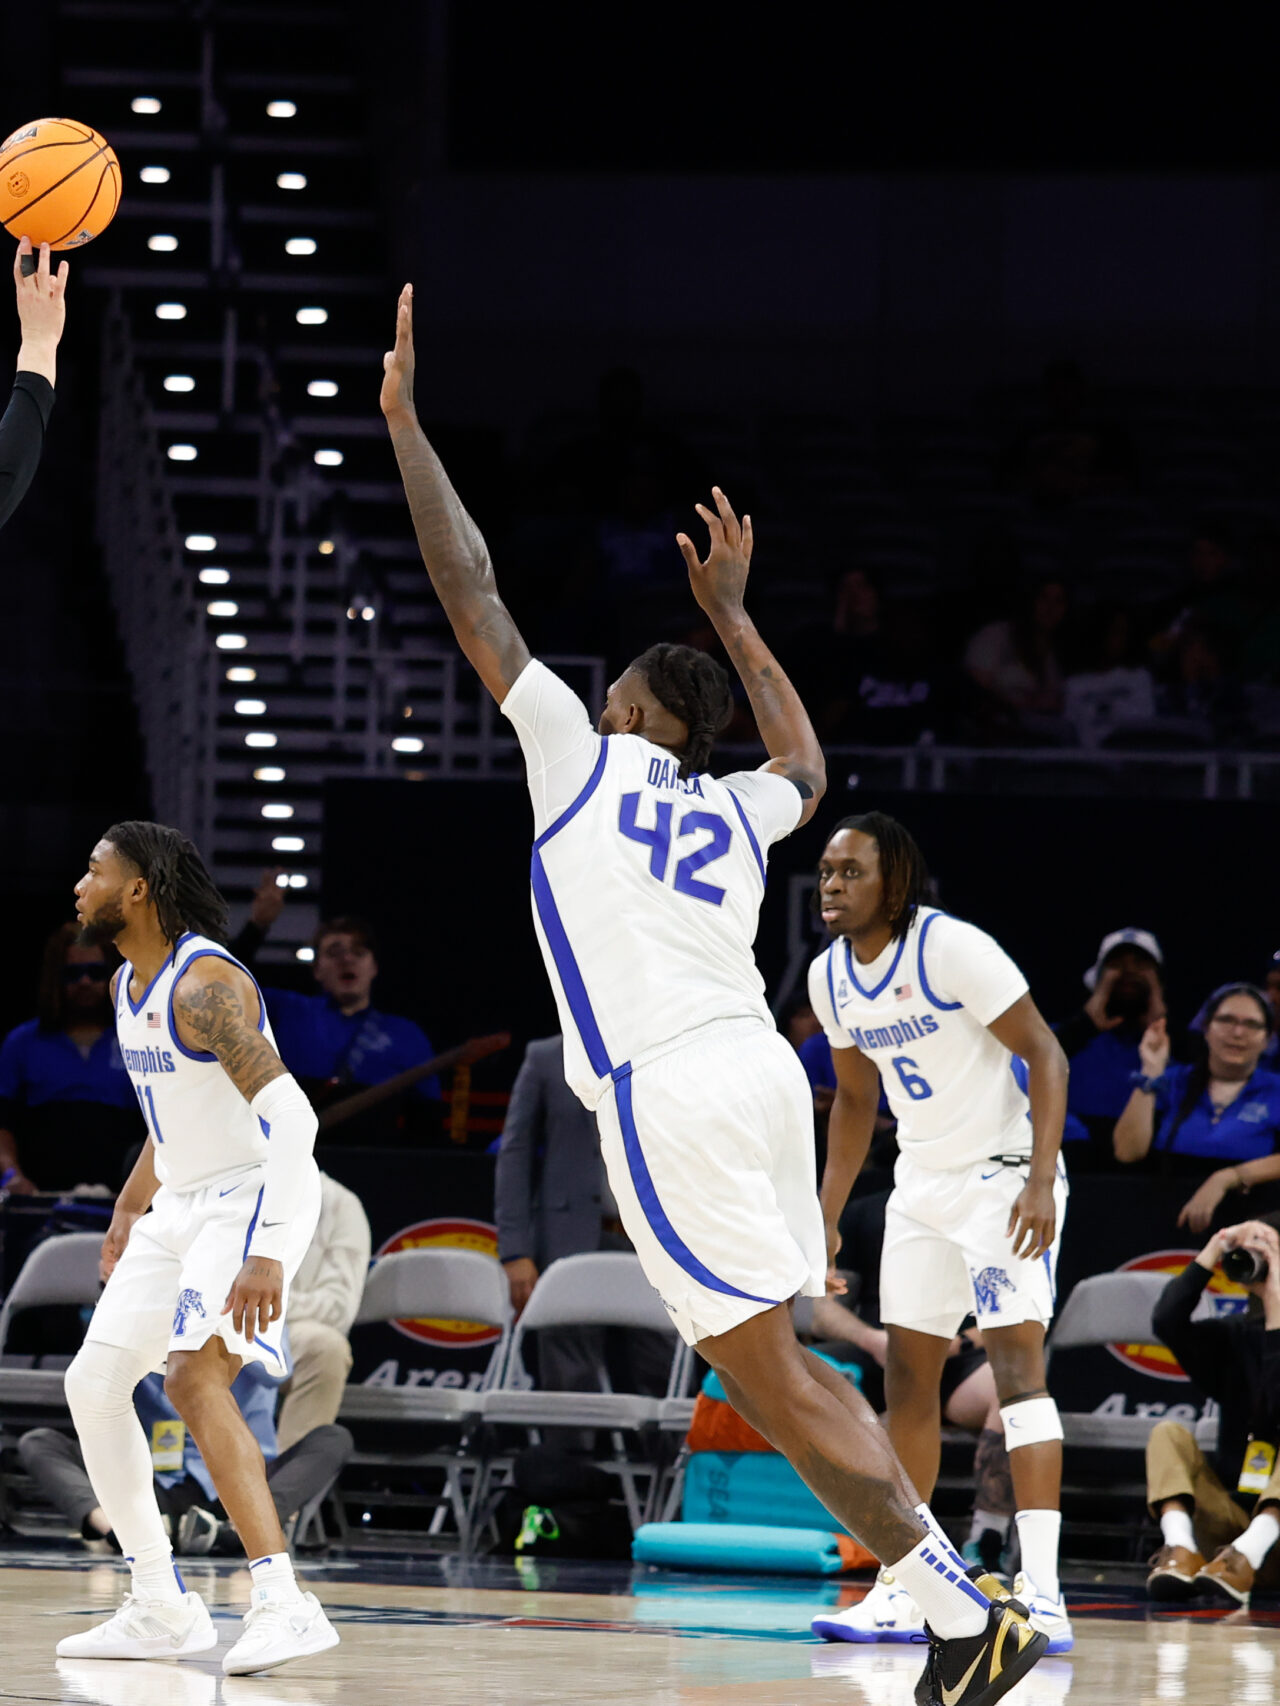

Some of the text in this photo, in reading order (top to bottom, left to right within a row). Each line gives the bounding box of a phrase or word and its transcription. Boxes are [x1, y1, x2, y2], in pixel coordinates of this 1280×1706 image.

[619, 790, 733, 908] 42
[847, 1013, 940, 1050] Memphis
[121, 1043, 176, 1077] emphis
[891, 1055, 933, 1101] 6
[136, 1084, 165, 1144] 11
